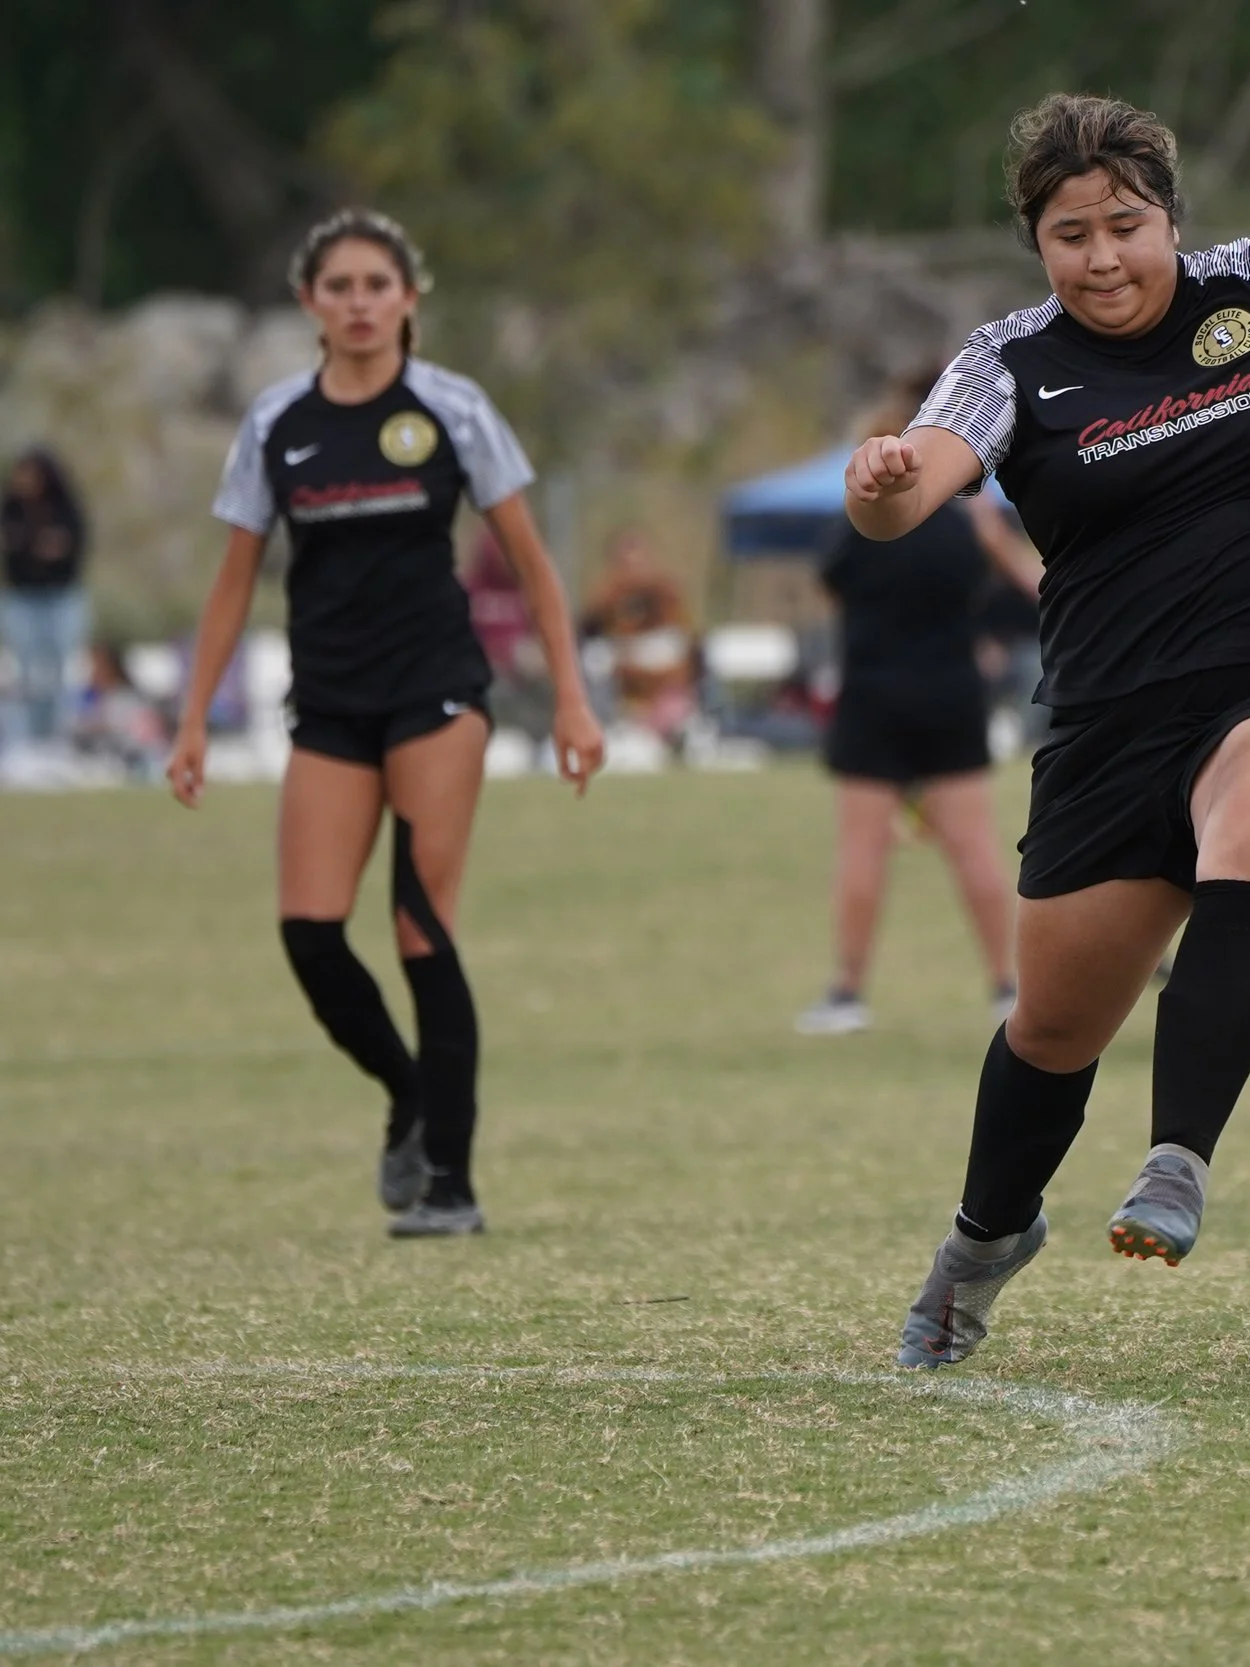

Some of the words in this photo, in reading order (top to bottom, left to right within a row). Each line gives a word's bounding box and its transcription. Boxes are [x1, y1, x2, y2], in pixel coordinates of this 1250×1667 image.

[1195, 319, 1215, 346] SOCAL
[1216, 310, 1242, 321] ELITE
[1200, 348, 1245, 365] FOOTBALL
